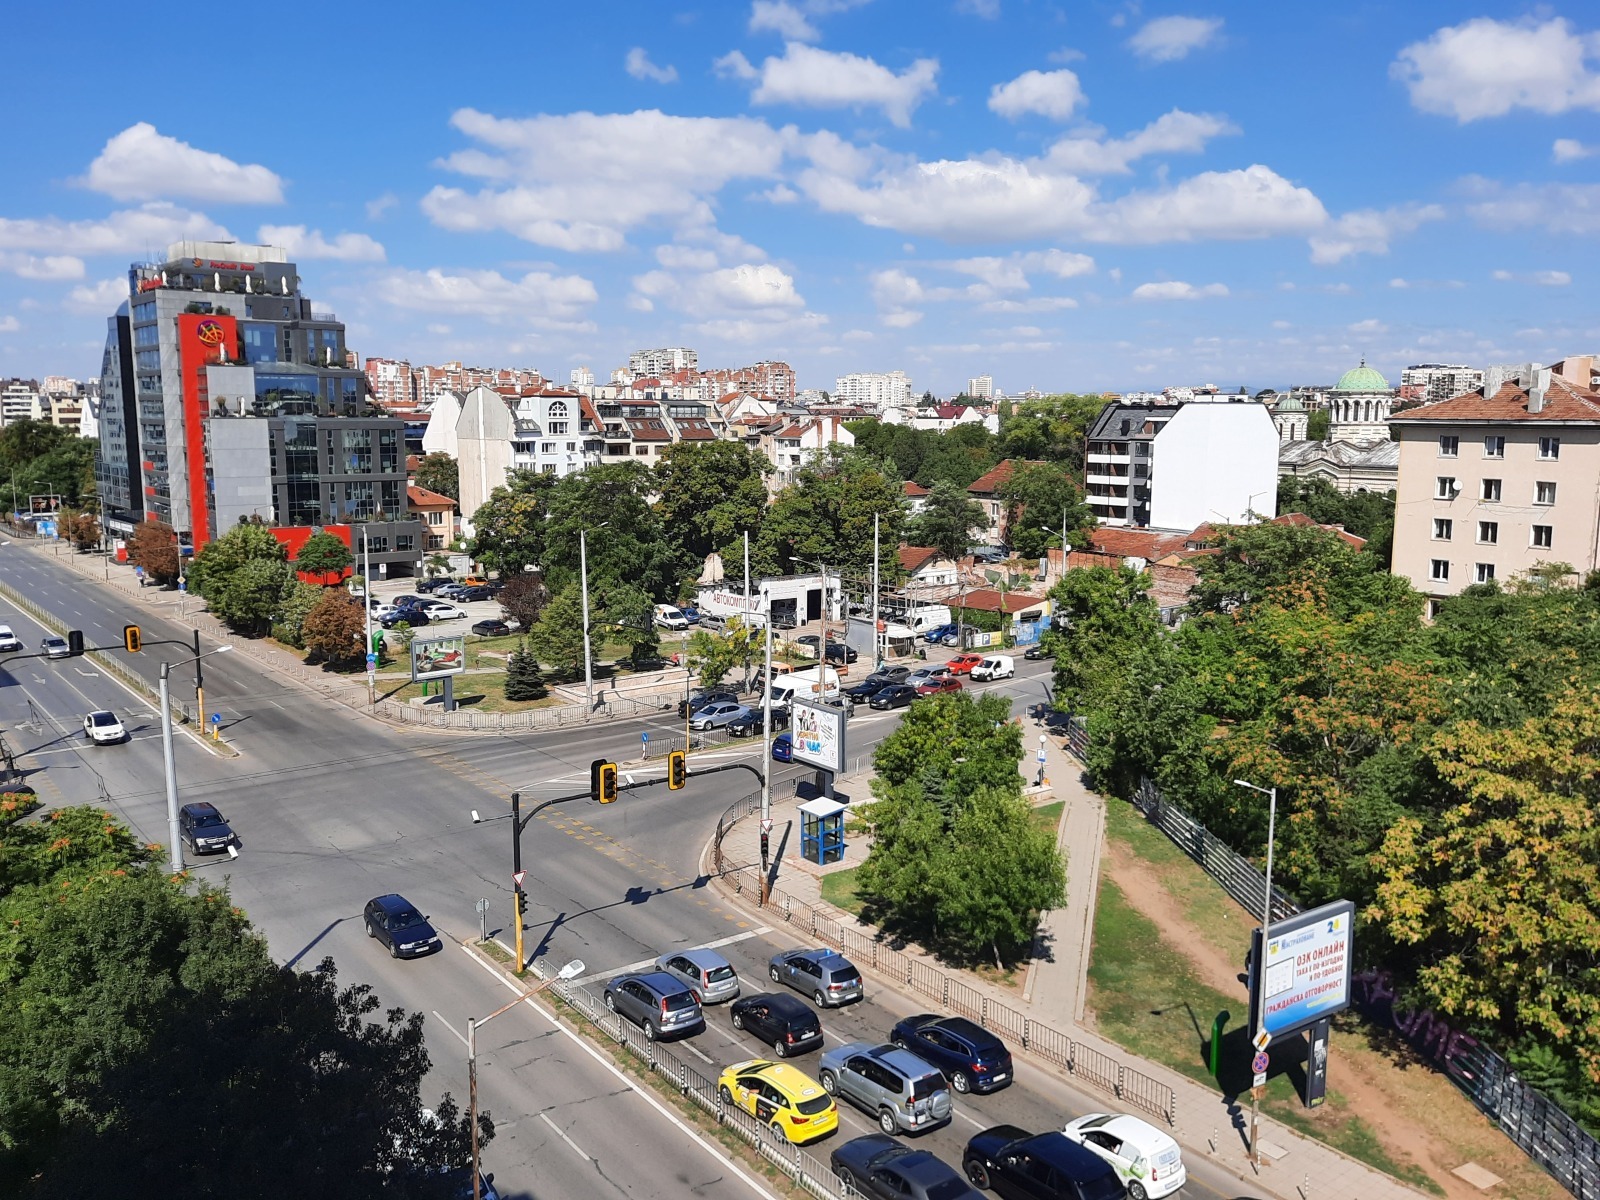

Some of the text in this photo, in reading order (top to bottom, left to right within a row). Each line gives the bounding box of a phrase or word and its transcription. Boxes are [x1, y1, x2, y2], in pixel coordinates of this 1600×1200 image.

[806, 740, 821, 753] ЧАС
[1296, 940, 1345, 966] ОЗК ОНЛАЙН
[1266, 994, 1303, 1015] ГРАЖДАНСКА
[1304, 979, 1342, 999] ОТГОВОРНОСТ
